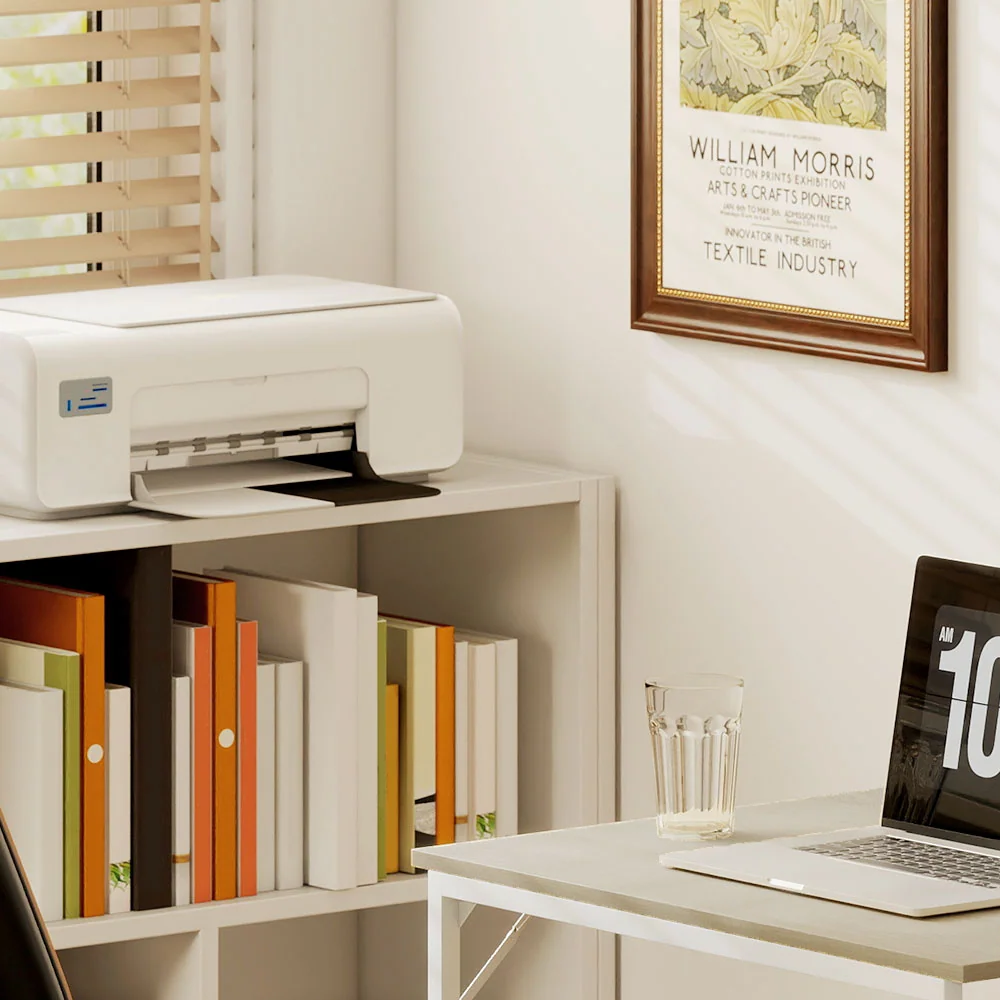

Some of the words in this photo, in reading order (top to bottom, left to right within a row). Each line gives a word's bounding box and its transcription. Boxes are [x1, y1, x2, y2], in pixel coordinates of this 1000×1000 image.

[690, 136, 776, 168] WILLIAM
[793, 148, 875, 181] MORRIS
[720, 165, 758, 178] COTTON
[761, 171, 792, 184] PRINTS
[795, 175, 846, 190] EXHIBITION
[708, 180, 737, 197] ARTS
[740, 184, 747, 198] &
[751, 185, 798, 205] CRAFTS
[801, 192, 852, 212] PIONEER
[725, 228, 772, 242] INNOVATOR
[774, 233, 782, 243] IN
[785, 234, 799, 246] THE
[802, 237, 831, 250] BRITISH
[704, 241, 767, 267] TEXTILE
[777, 251, 858, 279] INDUSTRY
[938, 626, 954, 643] AM
